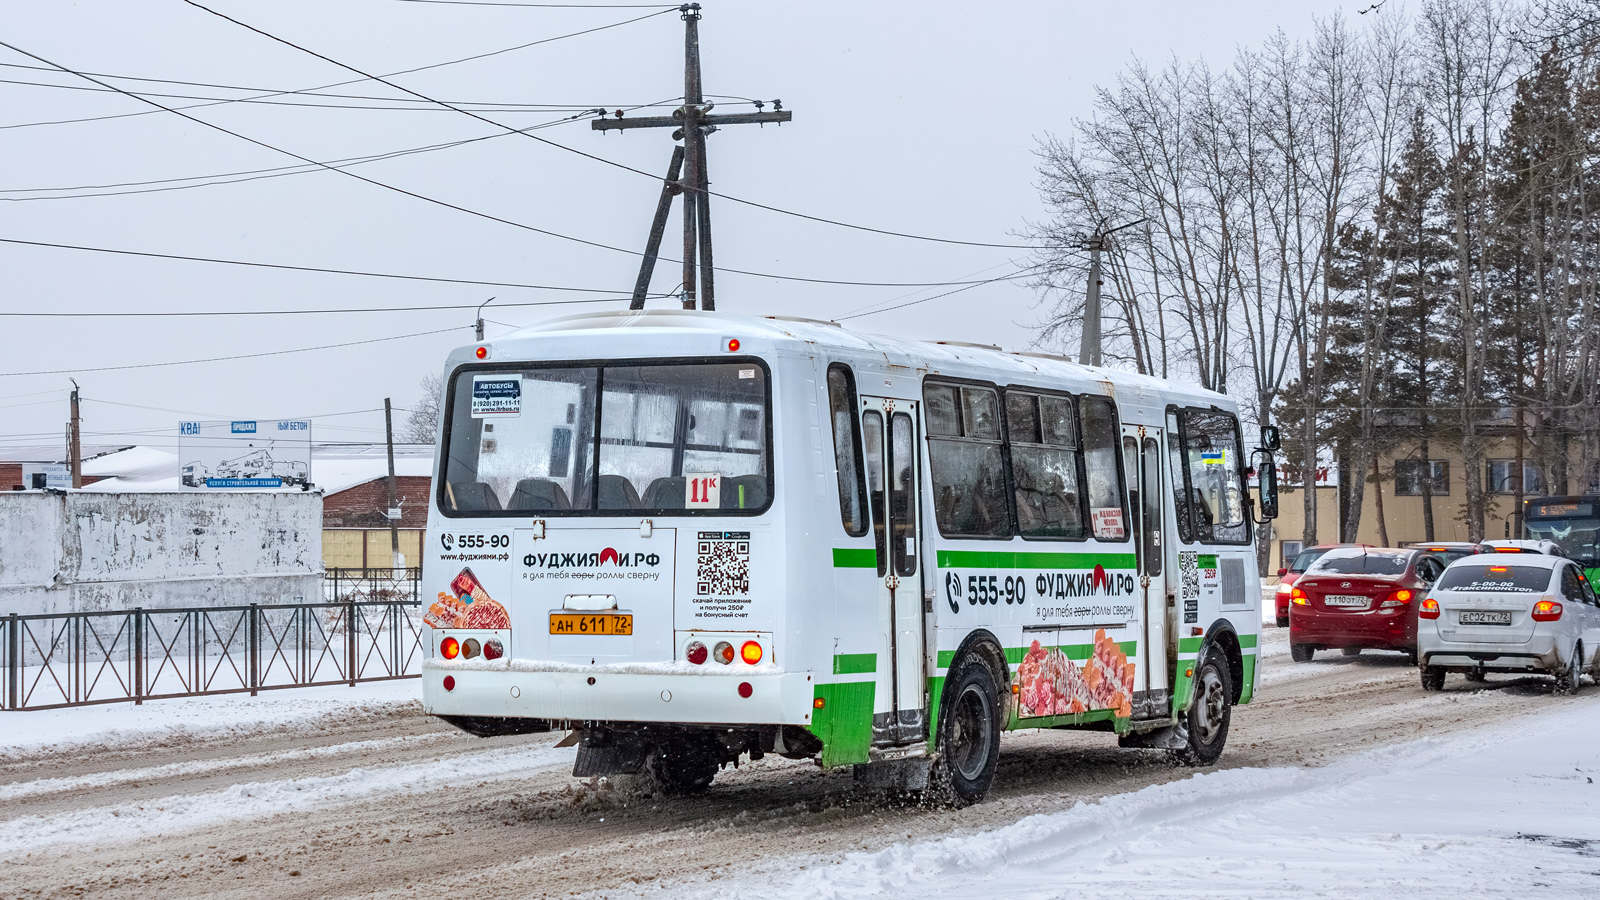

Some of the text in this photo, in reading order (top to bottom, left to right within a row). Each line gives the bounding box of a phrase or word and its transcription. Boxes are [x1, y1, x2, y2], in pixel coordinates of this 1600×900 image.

[480, 382, 514, 390] АВТОБУСЫ
[290, 421, 308, 431] БЕТОН
[458, 534, 510, 548] 555-90
[440, 552, 509, 562] www.фуджиями.рф
[529, 572, 544, 581] для
[546, 570, 569, 579] тебя
[596, 572, 625, 581] роллы
[627, 572, 660, 581] сверну
[967, 575, 1026, 606] 555-90
[703, 611, 734, 619] бонусный
[1036, 609, 1041, 618] я
[1041, 607, 1055, 621] для
[1055, 604, 1073, 618] тебя
[1091, 605, 1112, 620] роллы
[1112, 604, 1135, 619] сверну
[613, 616, 627, 629] 72
